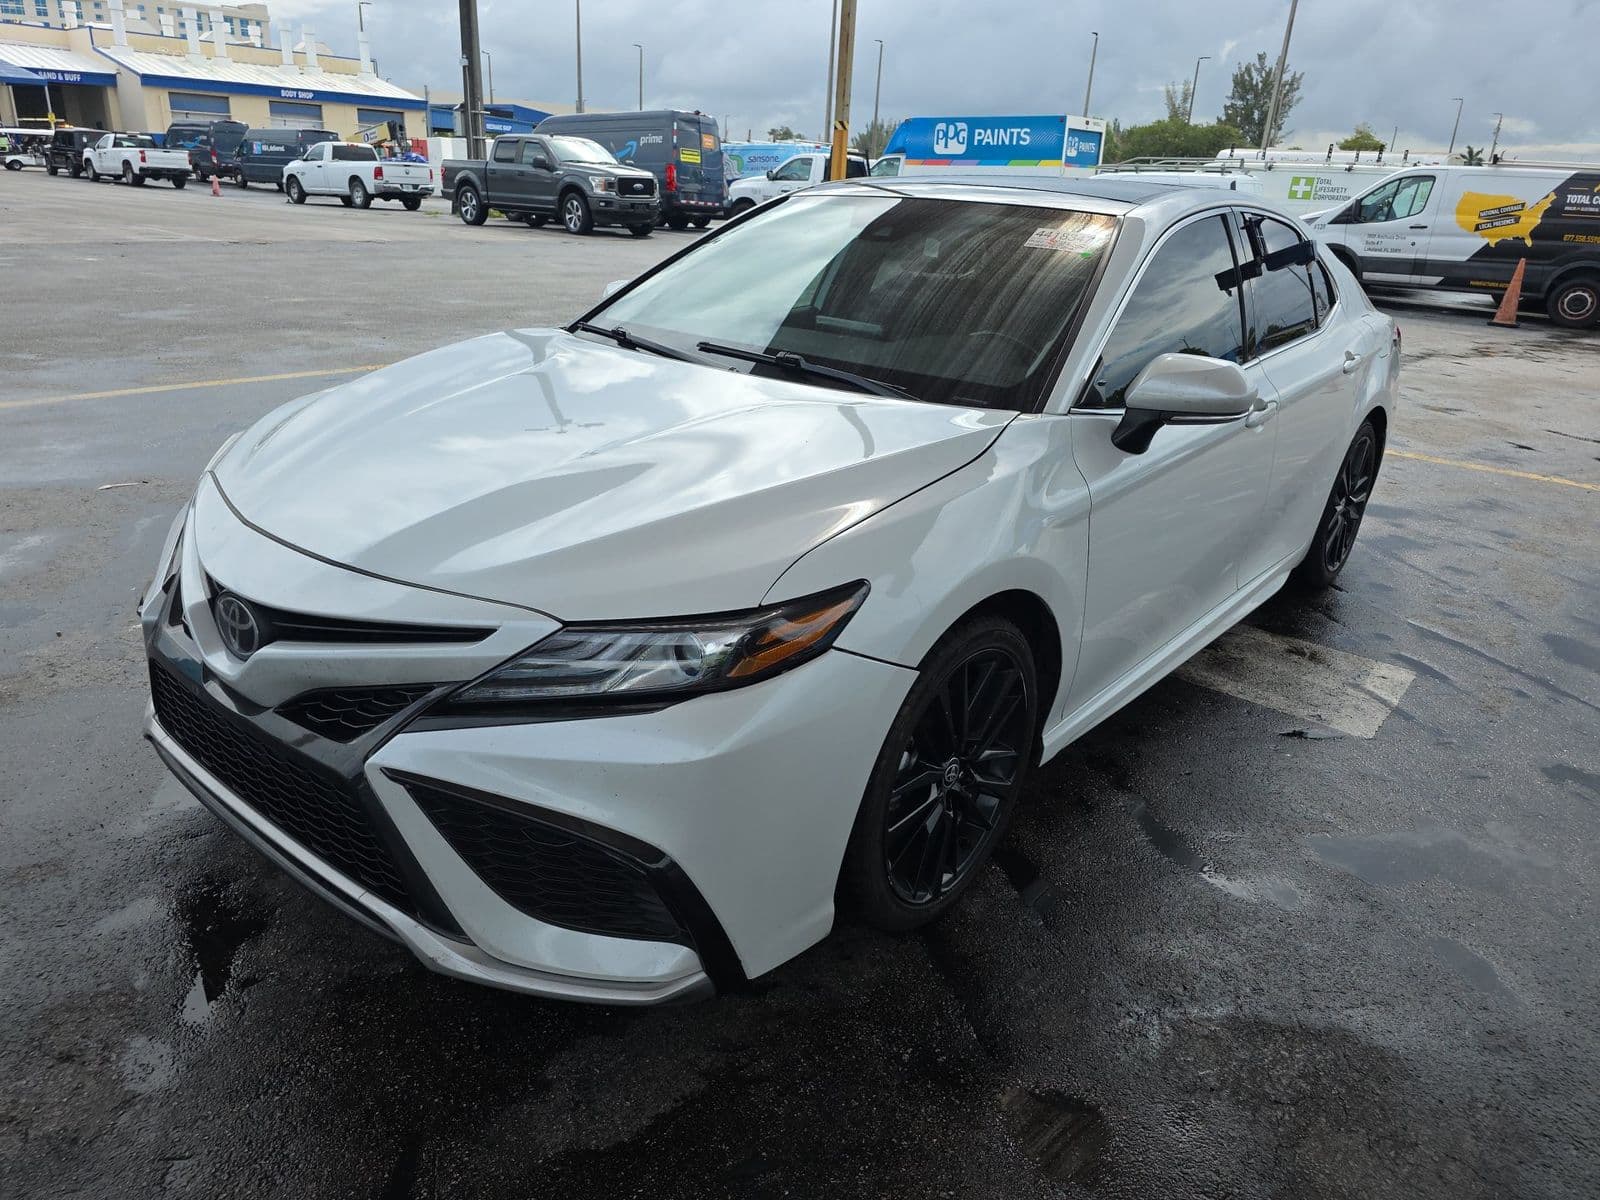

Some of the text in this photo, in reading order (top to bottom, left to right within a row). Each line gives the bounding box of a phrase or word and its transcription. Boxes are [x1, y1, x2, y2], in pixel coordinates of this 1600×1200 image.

[39, 71, 81, 82] SAND & BUFF
[281, 89, 314, 99] BODY SHOP
[640, 133, 663, 146] prime
[935, 122, 1031, 151] PPG PAINTS
[1079, 141, 1096, 153] PAINTS
[747, 155, 780, 163] sansone
[1315, 177, 1332, 185] TOTAL
[1314, 184, 1347, 193] LIFESAFETY
[1566, 194, 1591, 205] TOTAL
[1480, 208, 1501, 217] NATIONAL
[1478, 222, 1493, 230] LOCAL
